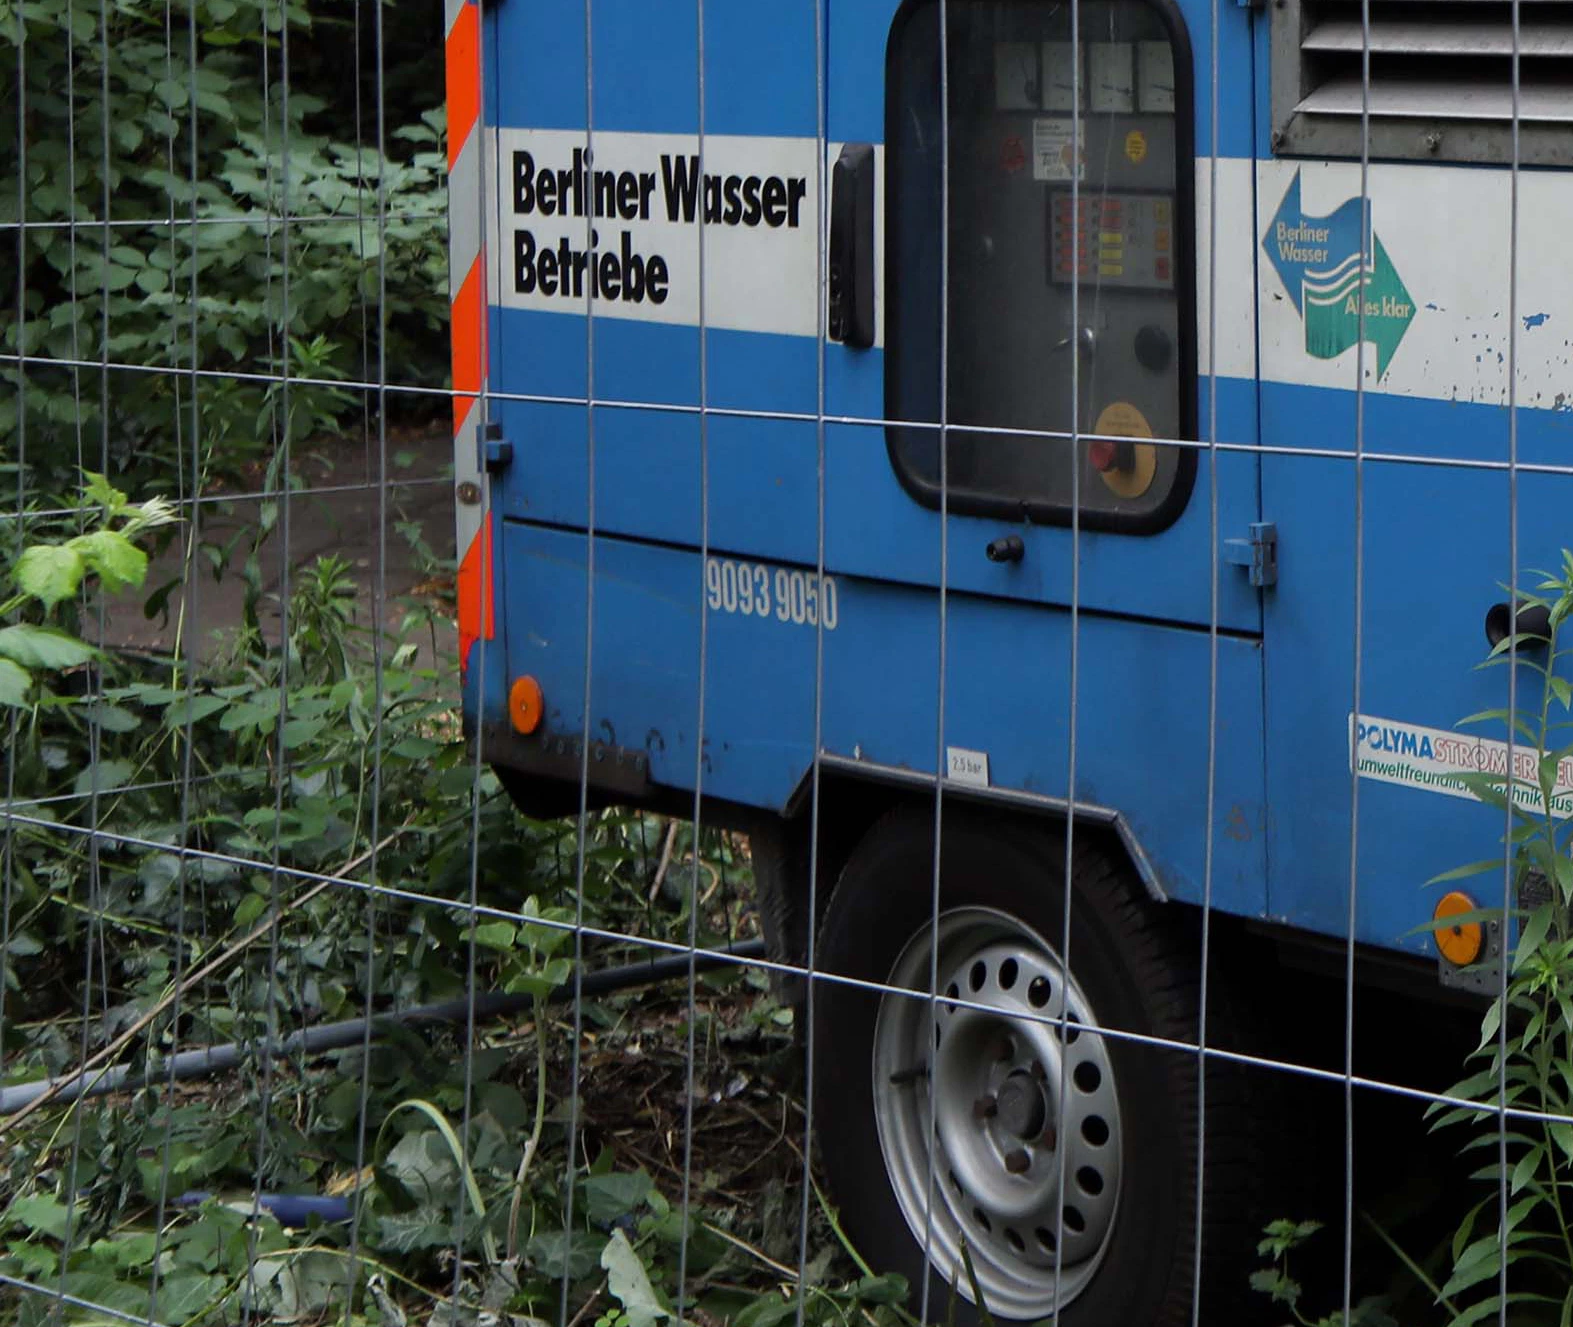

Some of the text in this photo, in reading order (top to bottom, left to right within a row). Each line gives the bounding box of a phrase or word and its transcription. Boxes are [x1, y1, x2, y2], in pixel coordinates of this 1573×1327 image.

[513, 146, 806, 228] Berliner Wasser
[1276, 221, 1329, 244] Berliner
[1278, 241, 1329, 263] Wasser
[513, 227, 669, 305] Betriebe
[1382, 296, 1411, 319] klar
[706, 557, 838, 631] 9093 9050
